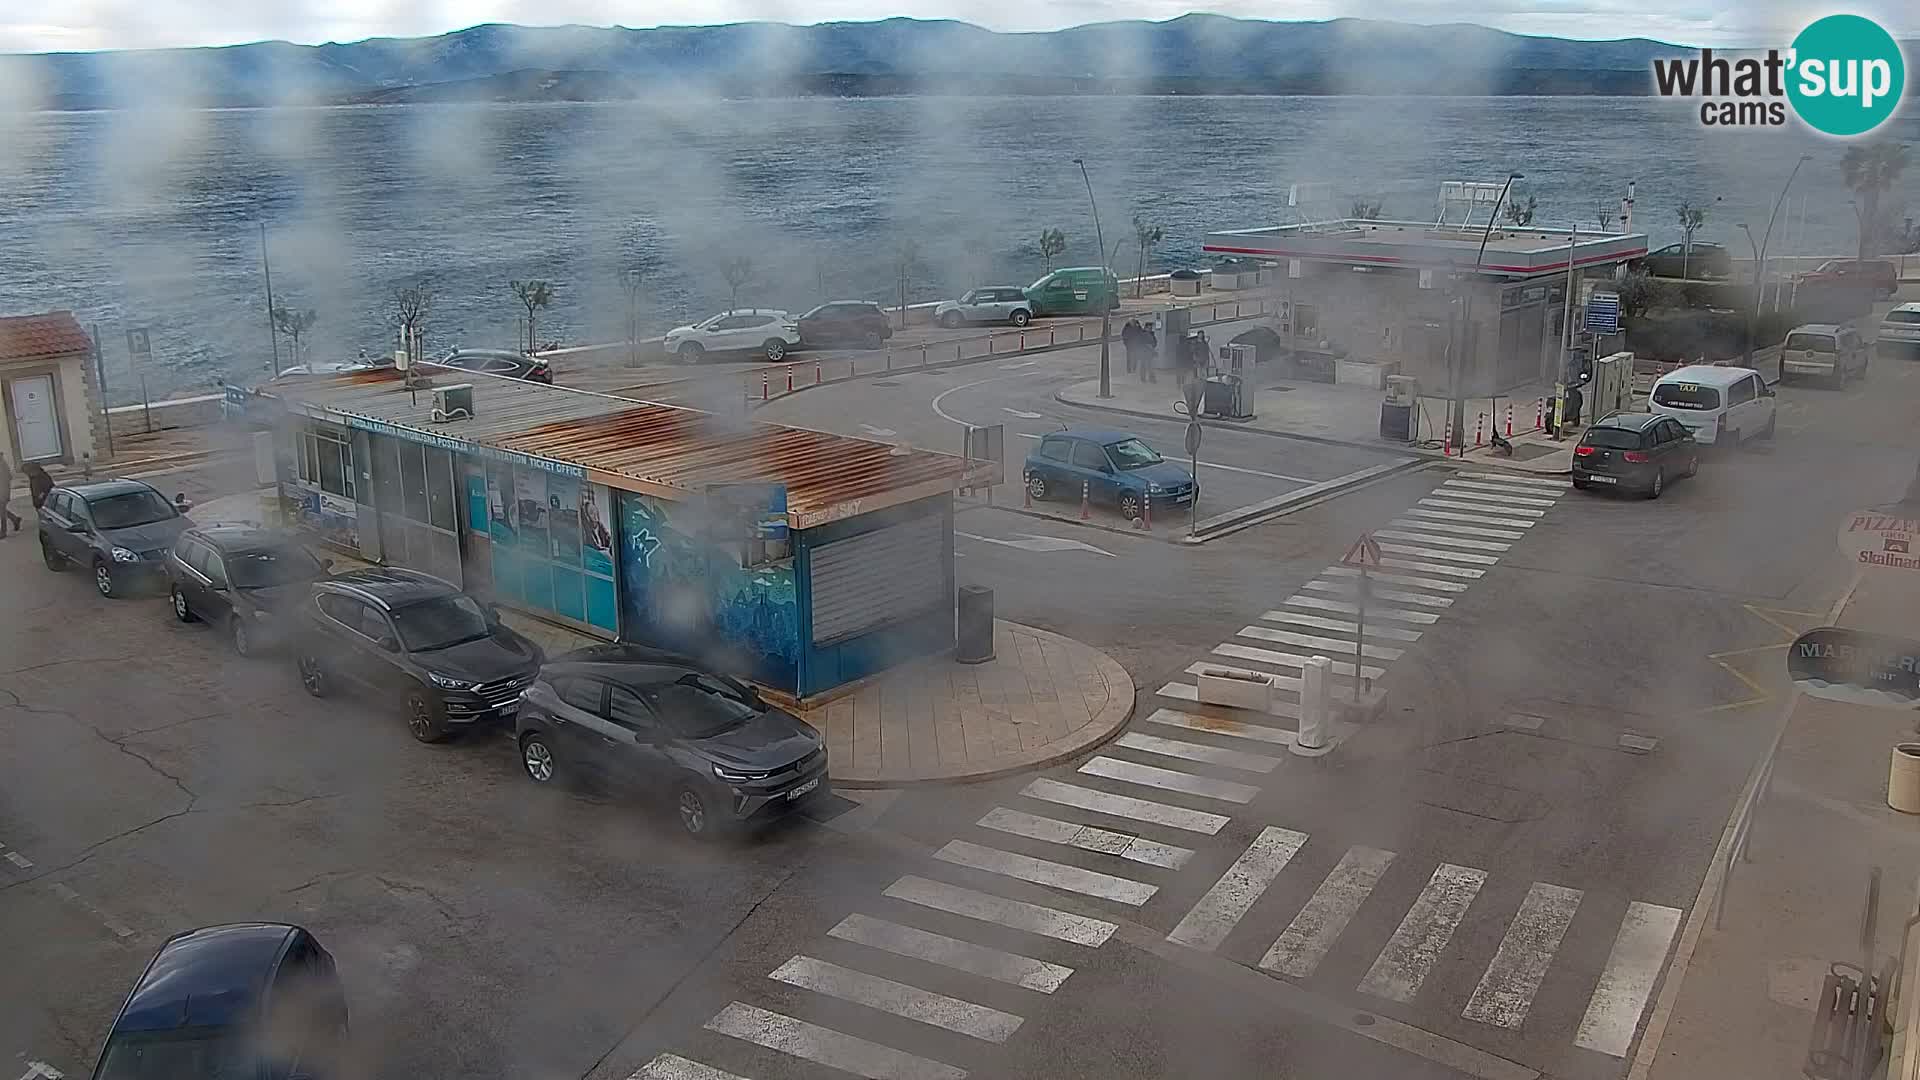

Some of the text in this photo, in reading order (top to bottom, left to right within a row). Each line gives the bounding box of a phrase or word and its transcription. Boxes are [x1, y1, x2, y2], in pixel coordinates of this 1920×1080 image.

[1679, 383, 1698, 393] TAXI
[530, 458, 555, 471] TICKET
[557, 464, 584, 478] OFFICE
